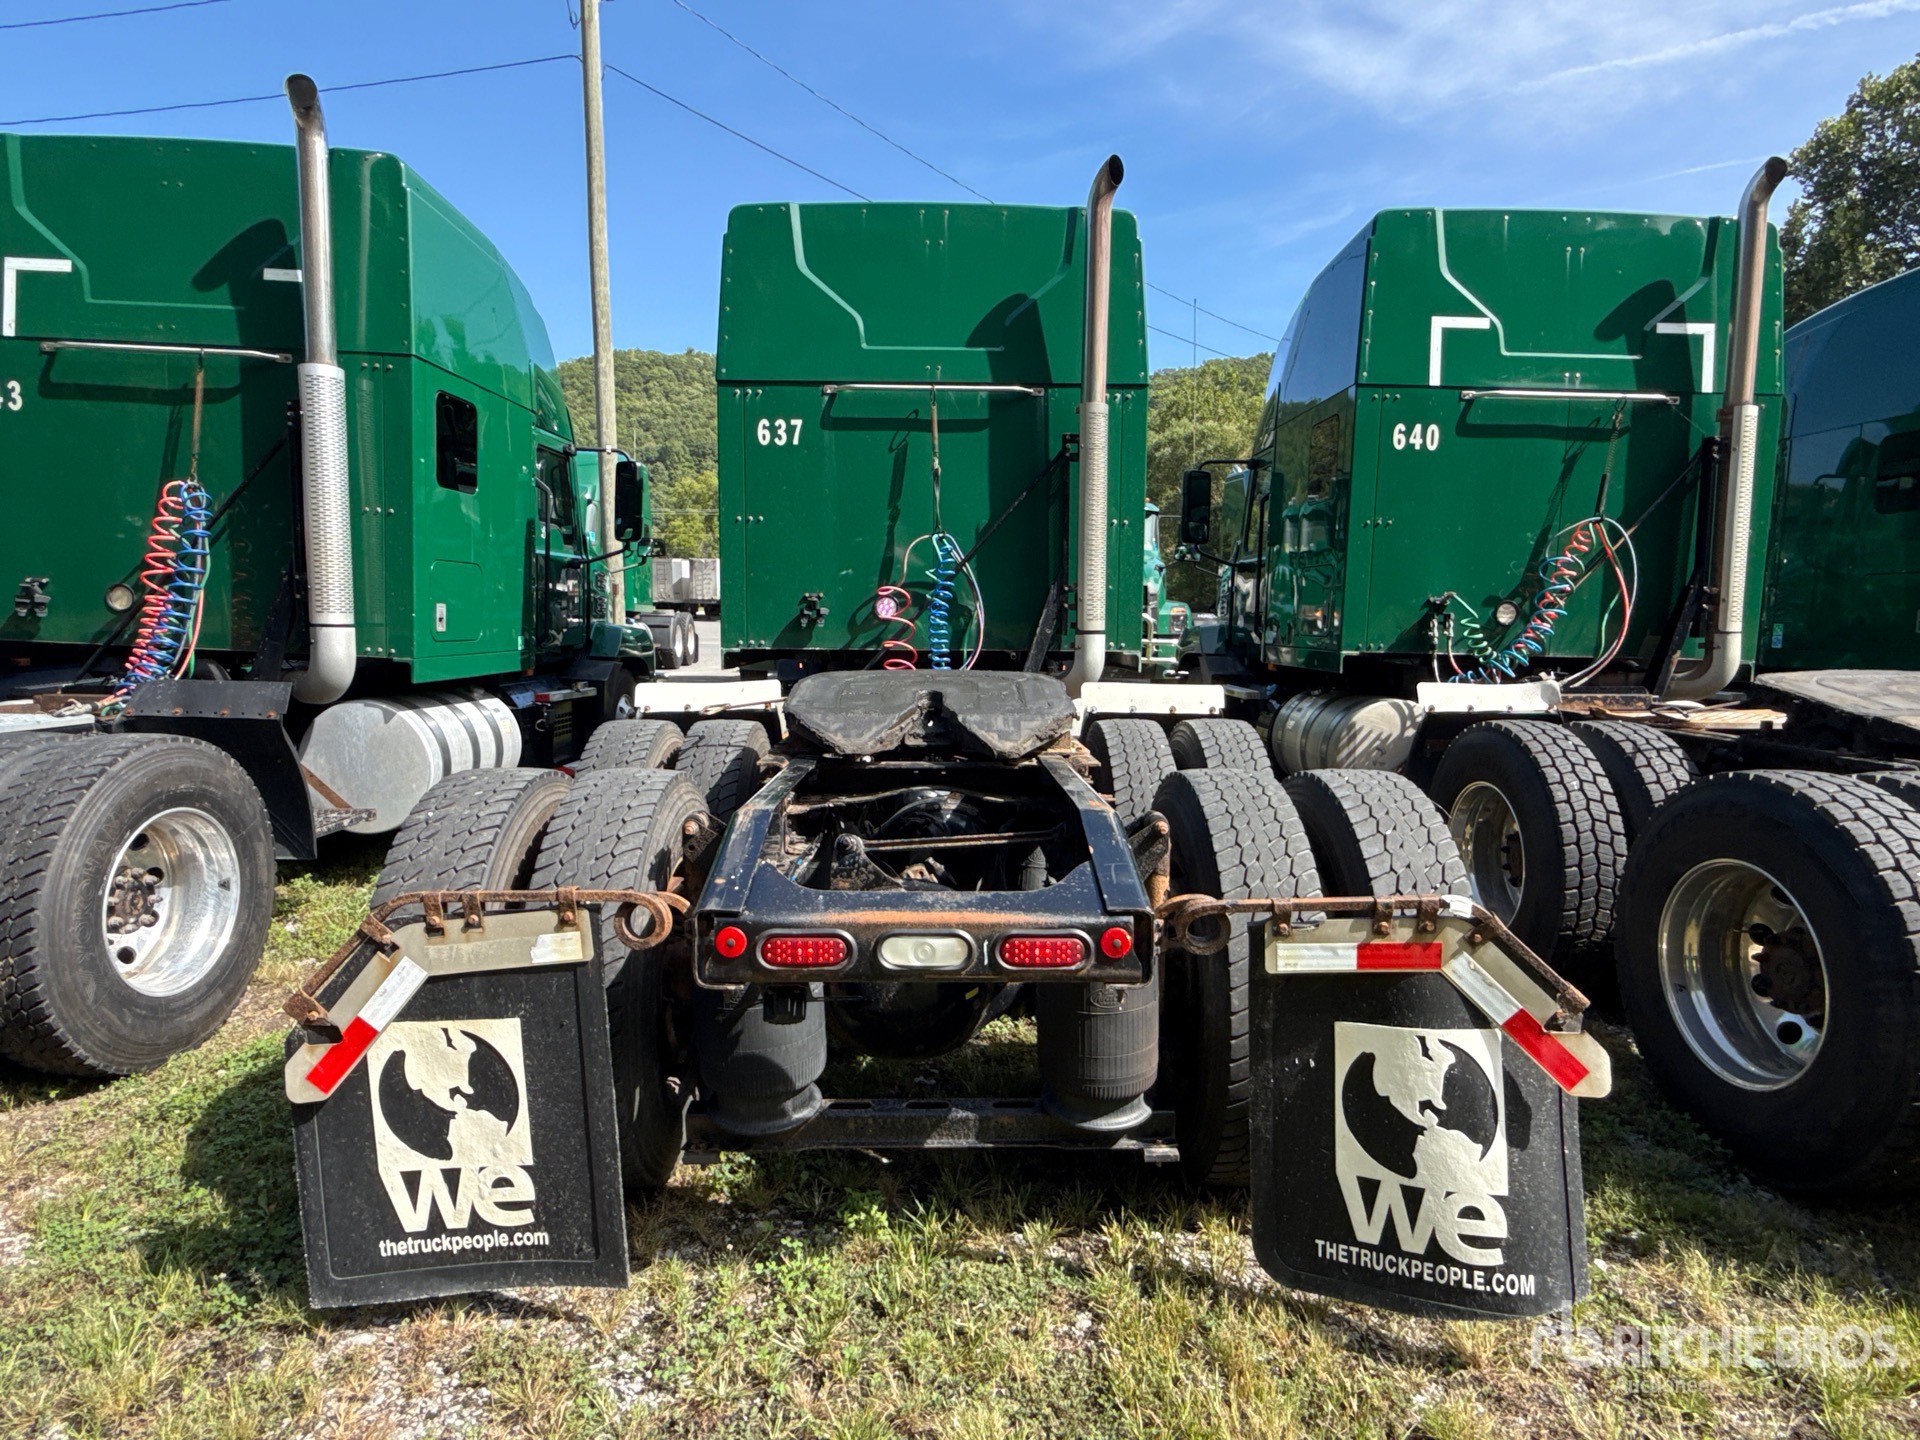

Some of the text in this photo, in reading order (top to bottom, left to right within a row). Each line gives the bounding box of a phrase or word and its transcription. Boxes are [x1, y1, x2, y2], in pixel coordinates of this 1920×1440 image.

[0, 380, 23, 411] 3
[757, 418, 803, 446] 637
[1392, 422, 1440, 451] 640
[378, 1164, 536, 1233] we
[1336, 1174, 1508, 1267] we
[378, 1229, 550, 1258] thetruckpeople.com
[1314, 1238, 1537, 1296] THETRUCKPEOPLE.COM
